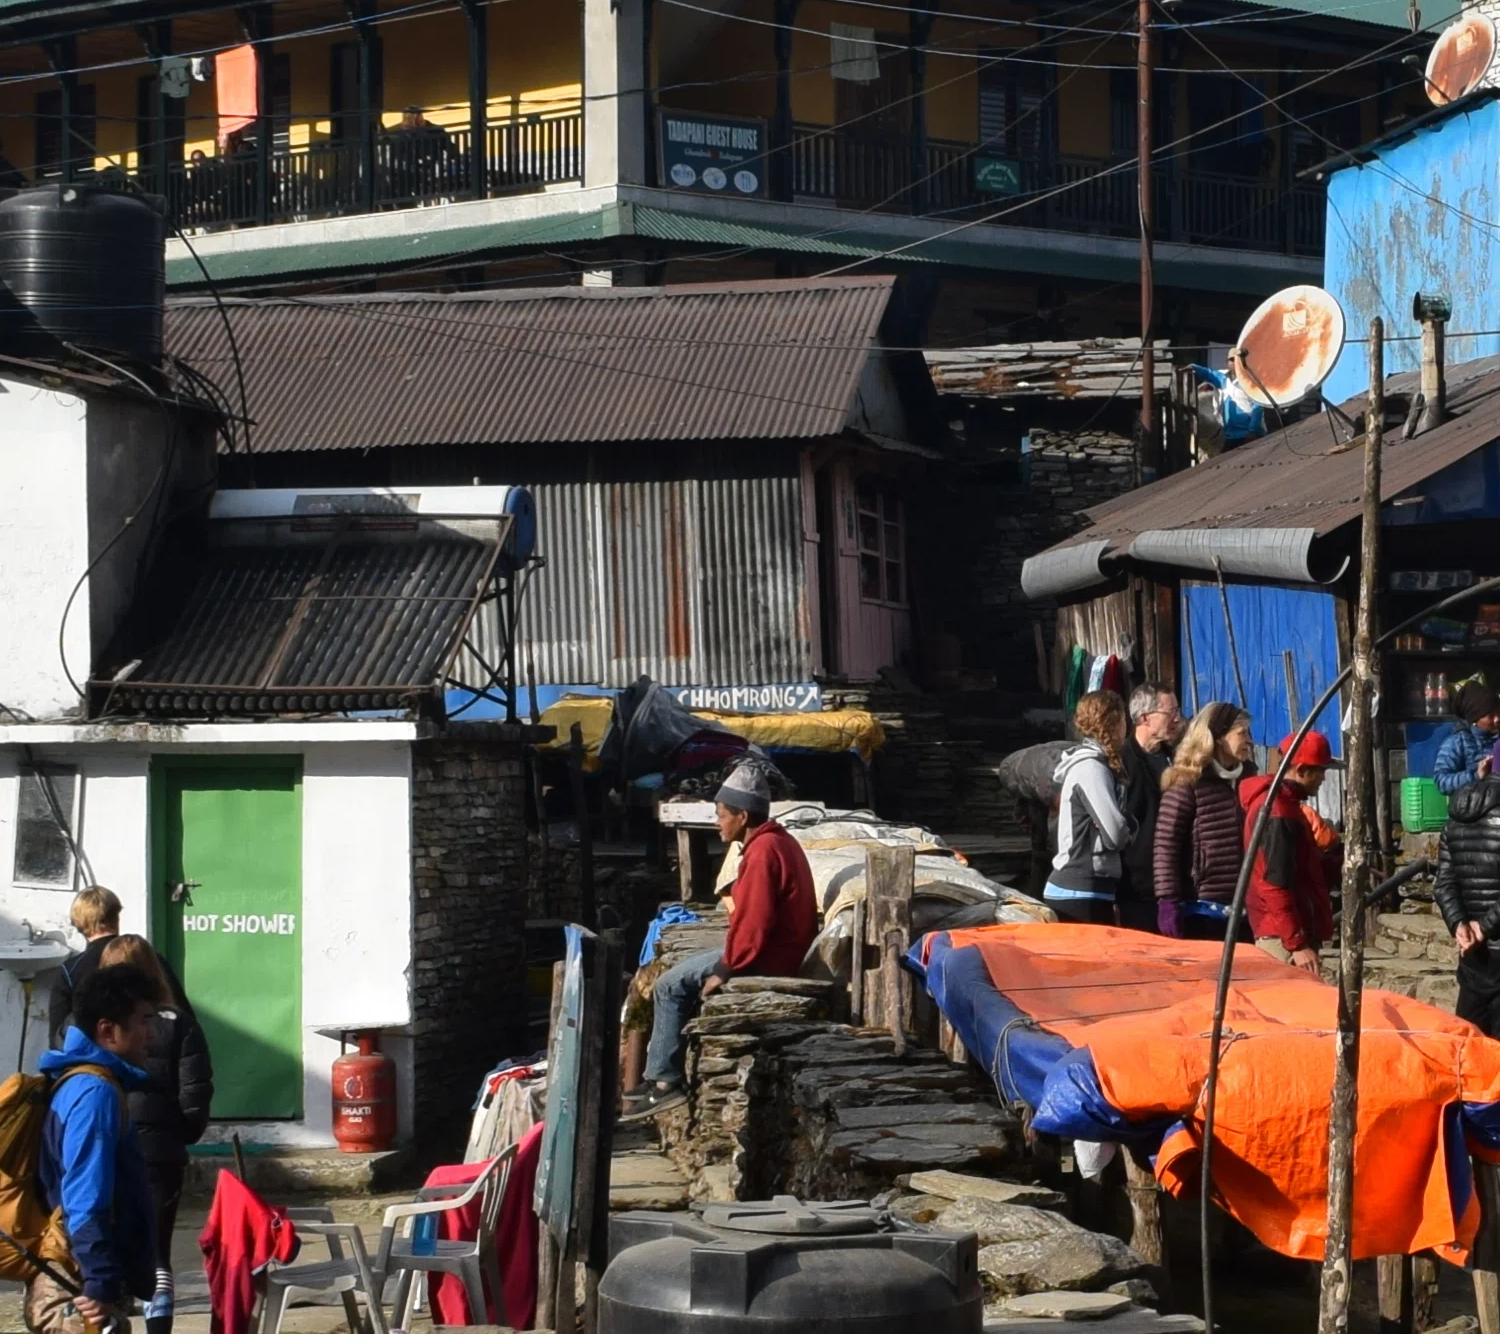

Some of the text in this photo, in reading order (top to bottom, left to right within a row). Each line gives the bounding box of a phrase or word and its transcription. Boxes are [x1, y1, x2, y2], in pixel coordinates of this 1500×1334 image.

[706, 125, 730, 147] GUEST
[732, 127, 757, 151] HOUSE
[677, 686, 796, 710] CHHOMRONG
[183, 913, 218, 932] HOT
